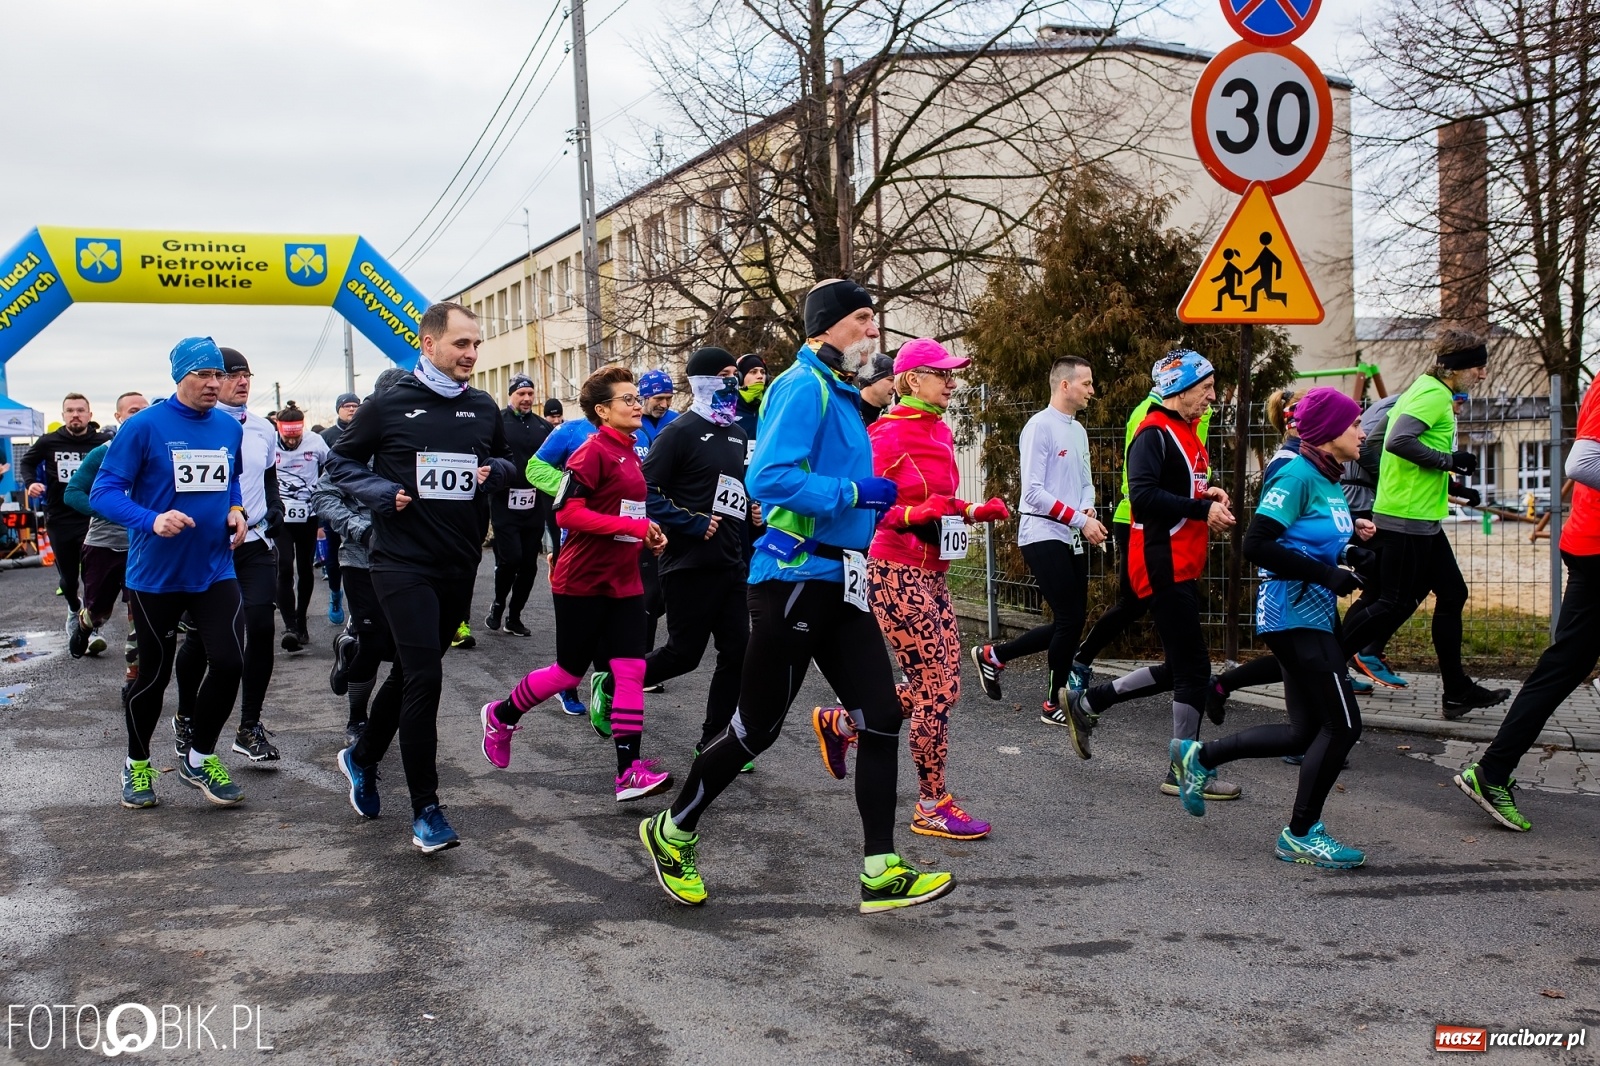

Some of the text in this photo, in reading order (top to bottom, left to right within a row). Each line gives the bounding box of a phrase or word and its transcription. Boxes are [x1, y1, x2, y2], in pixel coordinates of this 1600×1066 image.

[1216, 78, 1311, 156] 30
[162, 239, 246, 253] Gmina
[0, 252, 41, 291] ludzi
[141, 255, 269, 271] Pietrowice
[158, 273, 252, 289] Wielkie
[359, 261, 403, 305] Gmina
[0, 272, 56, 330] ywnych
[346, 279, 421, 350] aktywnych
[54, 451, 81, 462] FOB
[178, 465, 226, 483] 374
[420, 469, 474, 491] 403
[511, 496, 534, 506] 154
[717, 489, 746, 513] 422
[944, 531, 967, 551] 109
